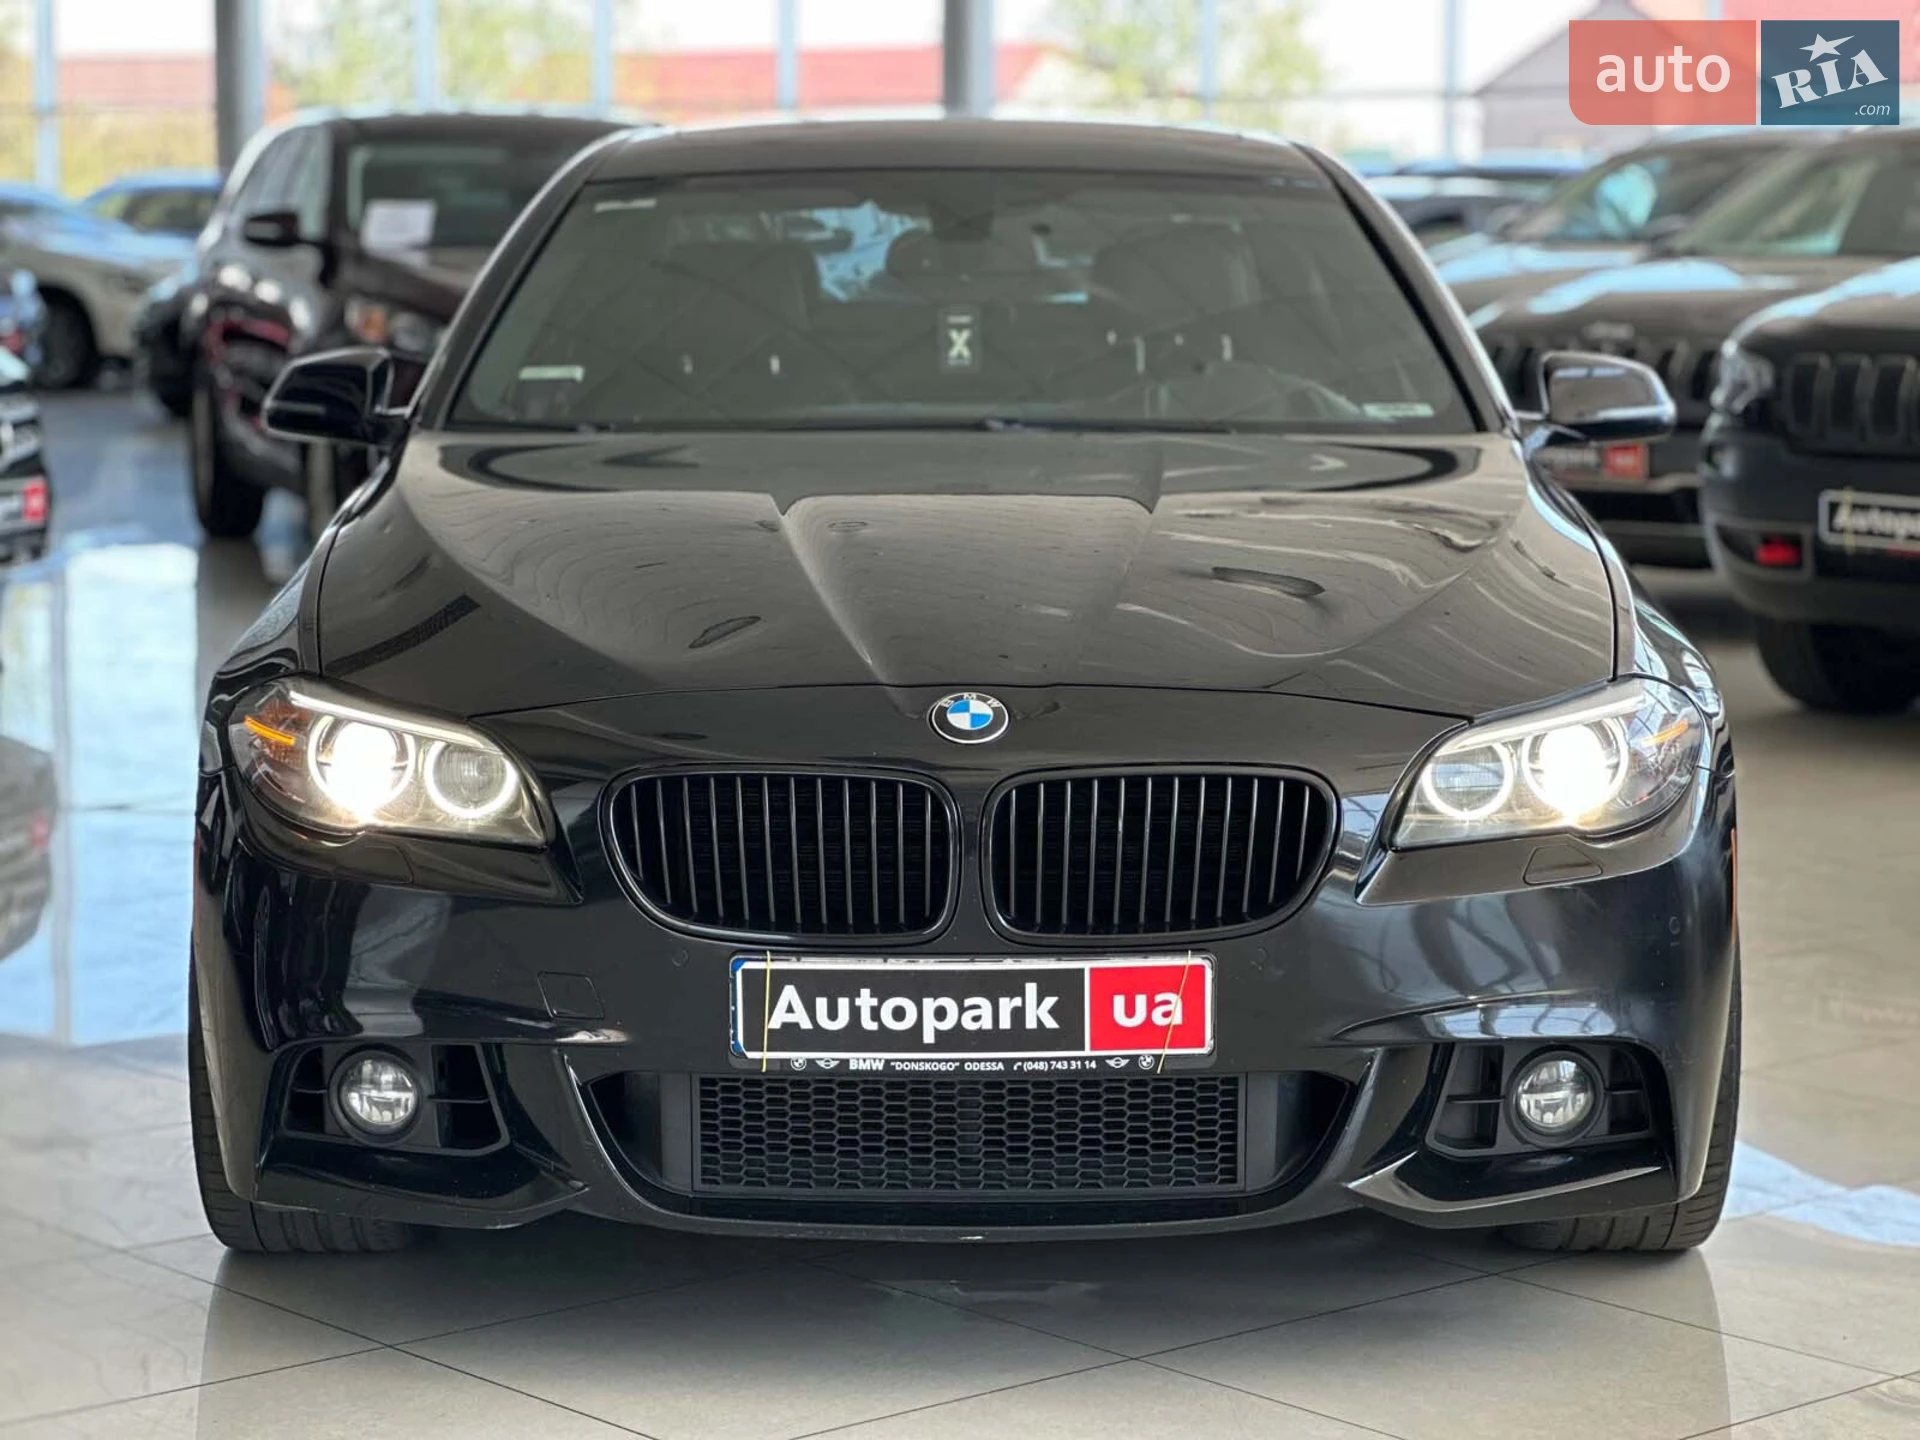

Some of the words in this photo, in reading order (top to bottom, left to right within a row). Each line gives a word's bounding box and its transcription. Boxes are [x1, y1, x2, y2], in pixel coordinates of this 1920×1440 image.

[768, 982, 1059, 1044] Autopark
[1112, 992, 1184, 1028] ua
[849, 1058, 885, 1071] BMW
[964, 1061, 1004, 1071] ODESSA
[1023, 1060, 1048, 1071] (048)
[1050, 1060, 1068, 1070] 743
[1070, 1060, 1082, 1070] 31
[1085, 1060, 1097, 1070] 14
